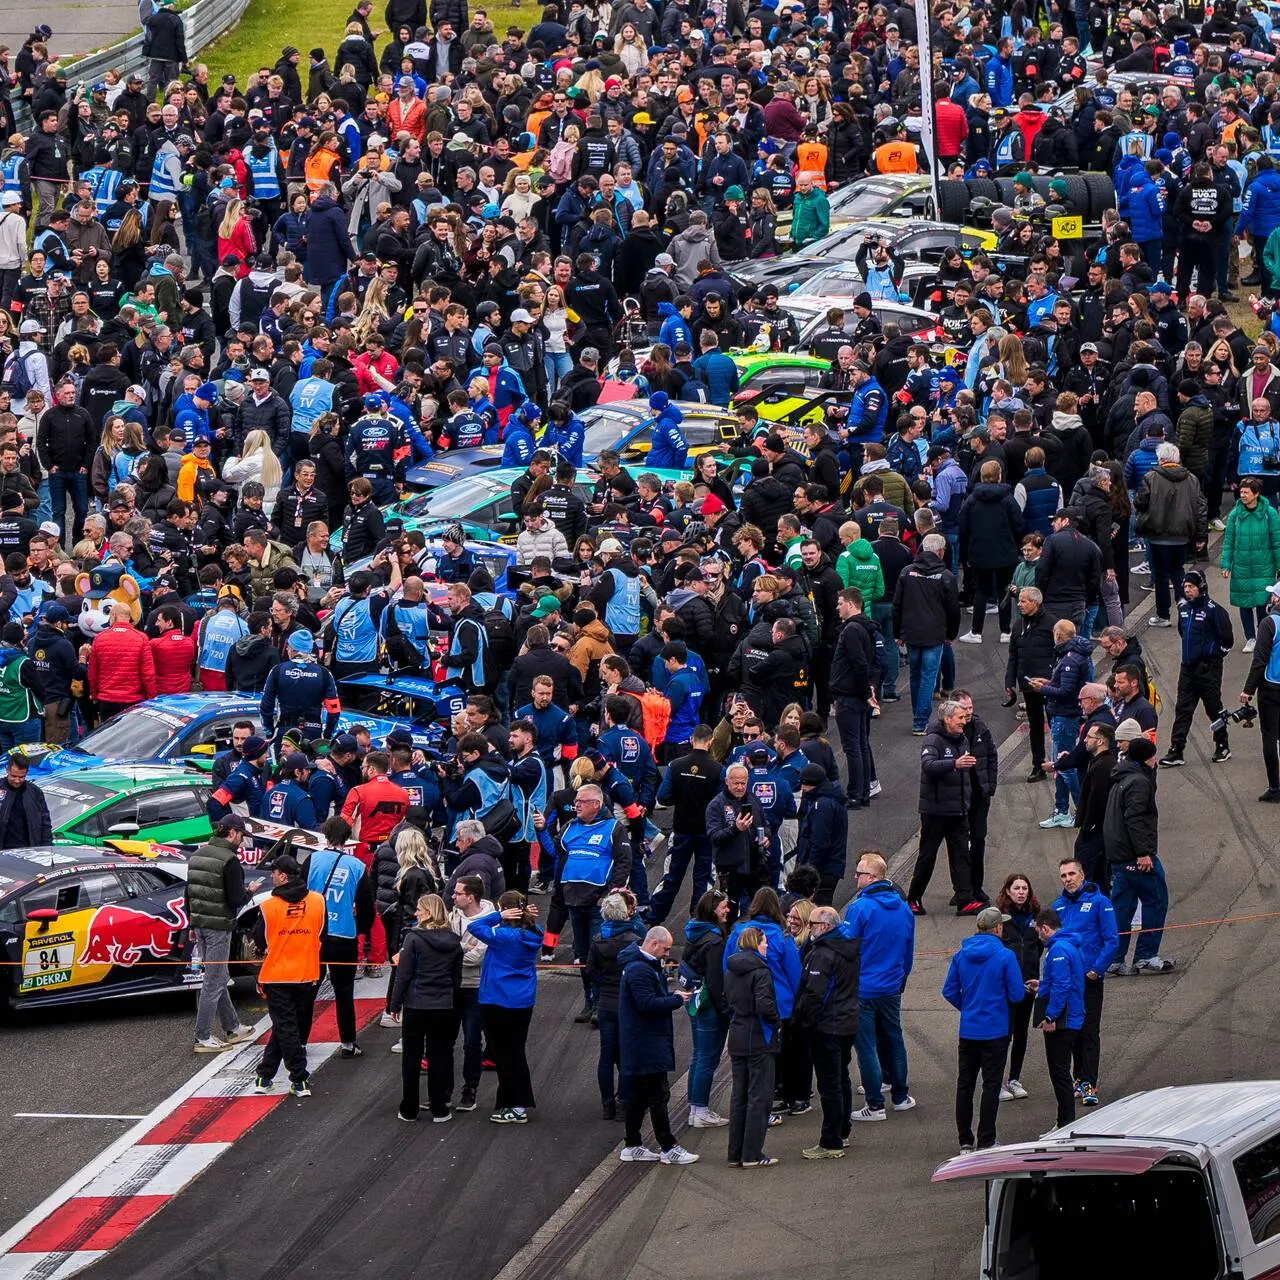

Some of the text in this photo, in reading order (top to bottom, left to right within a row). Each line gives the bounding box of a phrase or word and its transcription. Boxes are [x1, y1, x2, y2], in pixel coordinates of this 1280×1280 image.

[300, 397, 313, 407] TV
[626, 594, 638, 606] TV
[207, 632, 234, 645] MEDIA
[210, 650, 224, 660] 720
[285, 669, 318, 678] SCHERER
[368, 800, 406, 818] ABT
[325, 889, 345, 904] TV
[31, 934, 71, 947] RAVENOL
[40, 953, 58, 970] 84
[36, 973, 67, 988] DEKRA
